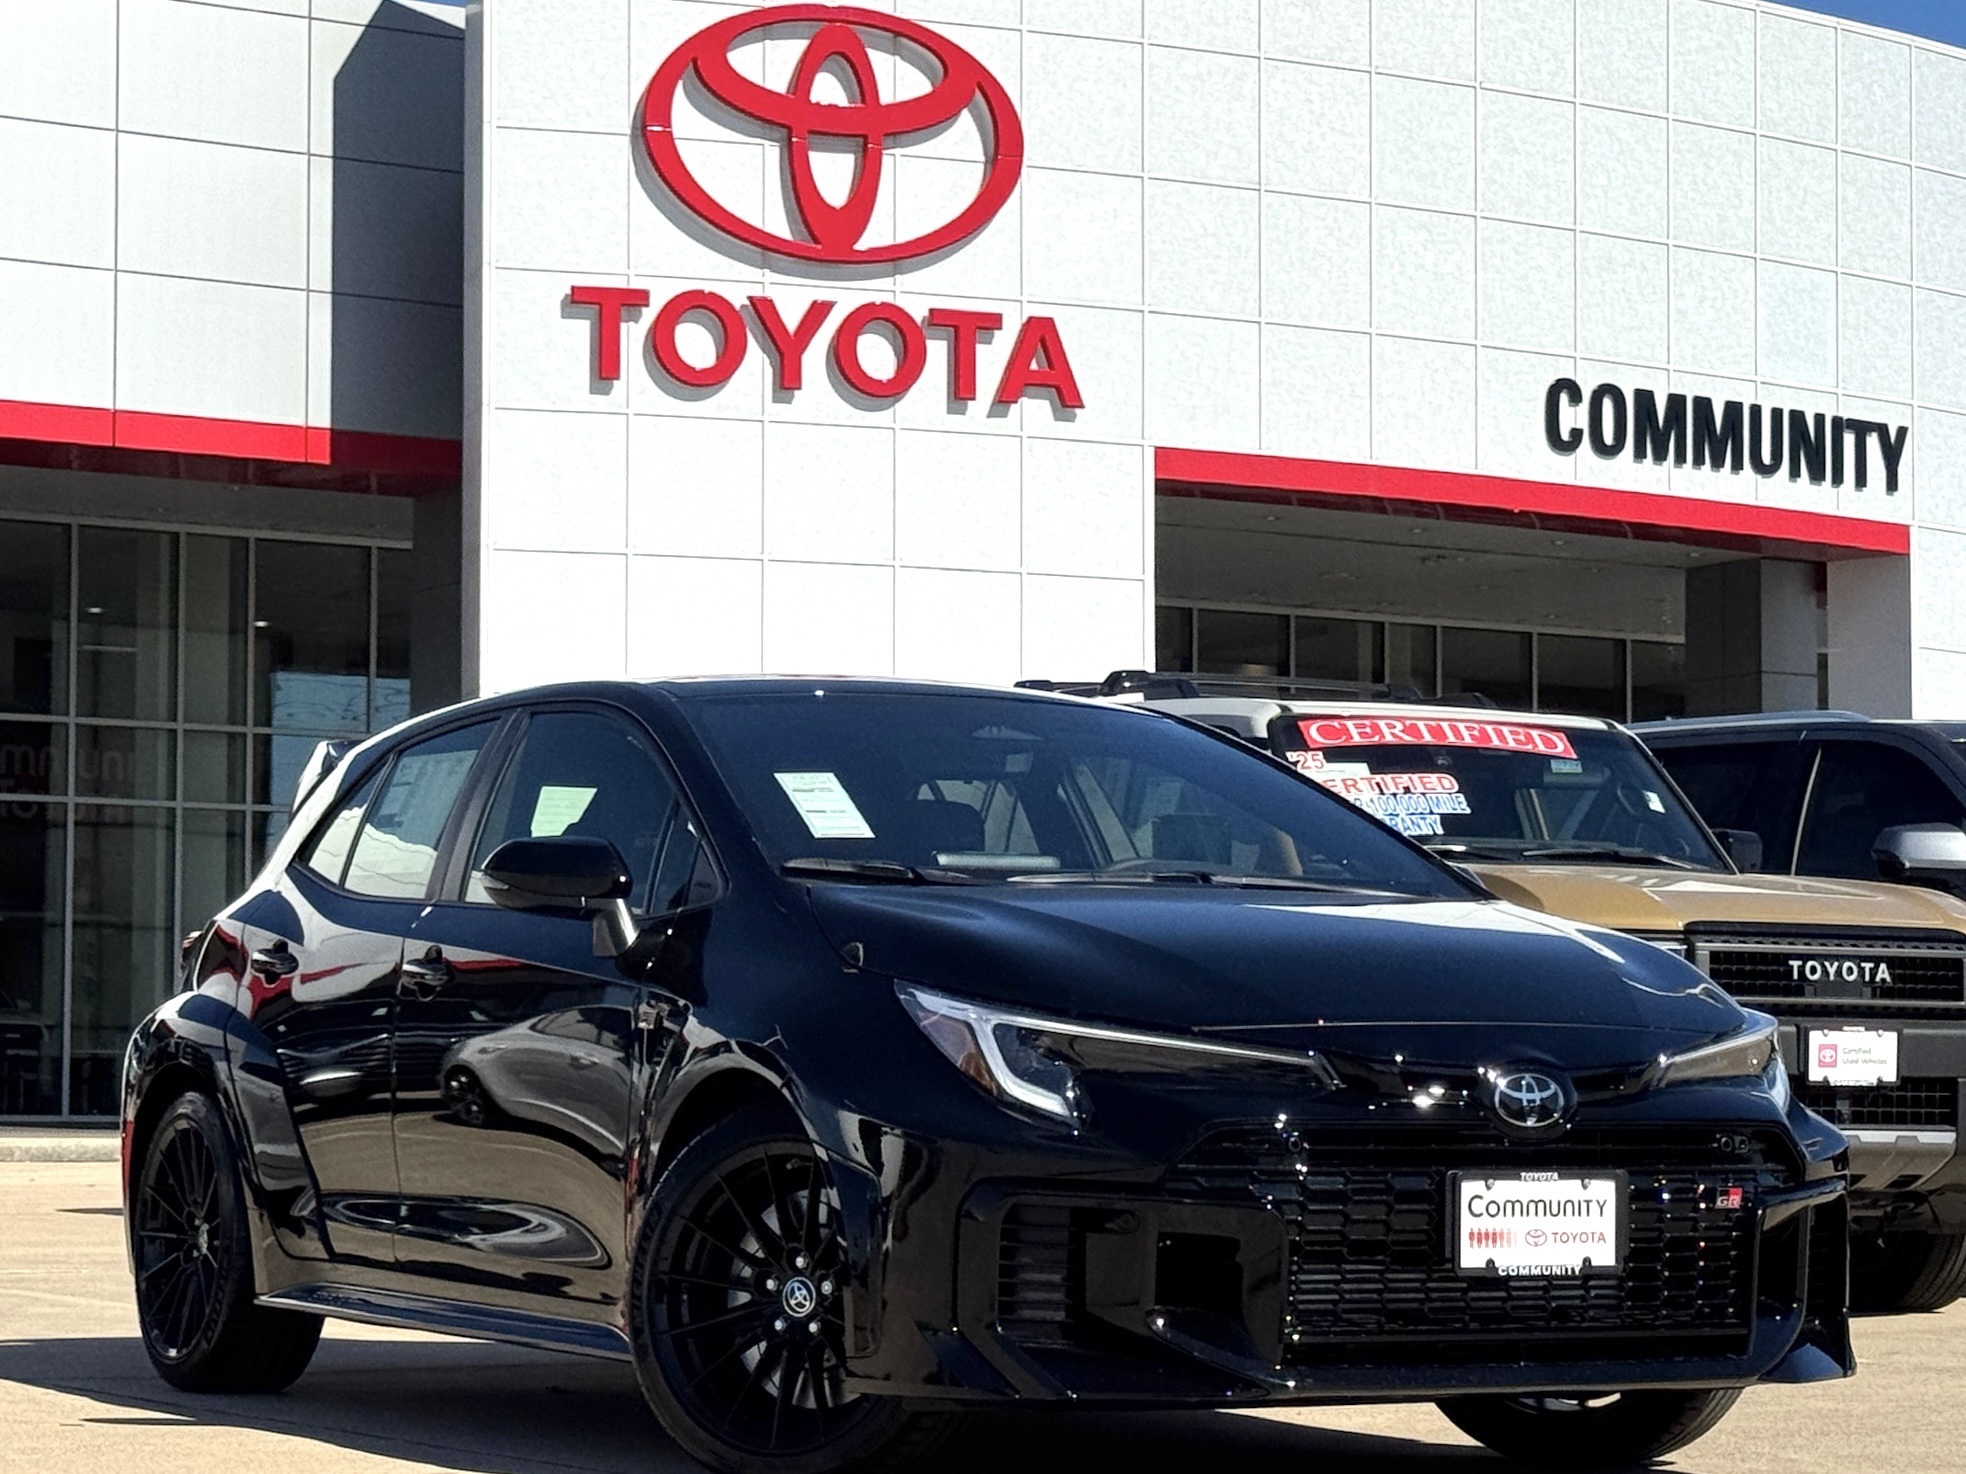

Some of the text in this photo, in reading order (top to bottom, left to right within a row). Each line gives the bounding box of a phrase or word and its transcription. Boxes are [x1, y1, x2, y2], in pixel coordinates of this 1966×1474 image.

[570, 285, 1085, 409] TOYOTA
[1544, 377, 1909, 494] COMMUNITY
[1308, 719, 1566, 753] CERTIFIED
[1320, 775, 1455, 794] ERTIFIED
[1429, 795, 1467, 811] MILE
[1381, 816, 1443, 833] RANTY
[1788, 960, 1892, 983] TOYOTA
[1520, 1172, 1559, 1182] TOYOTA
[1717, 1195, 1740, 1208] GR
[1551, 1231, 1607, 1244] TOYOTA
[1497, 1264, 1583, 1277] COMMUNITY
